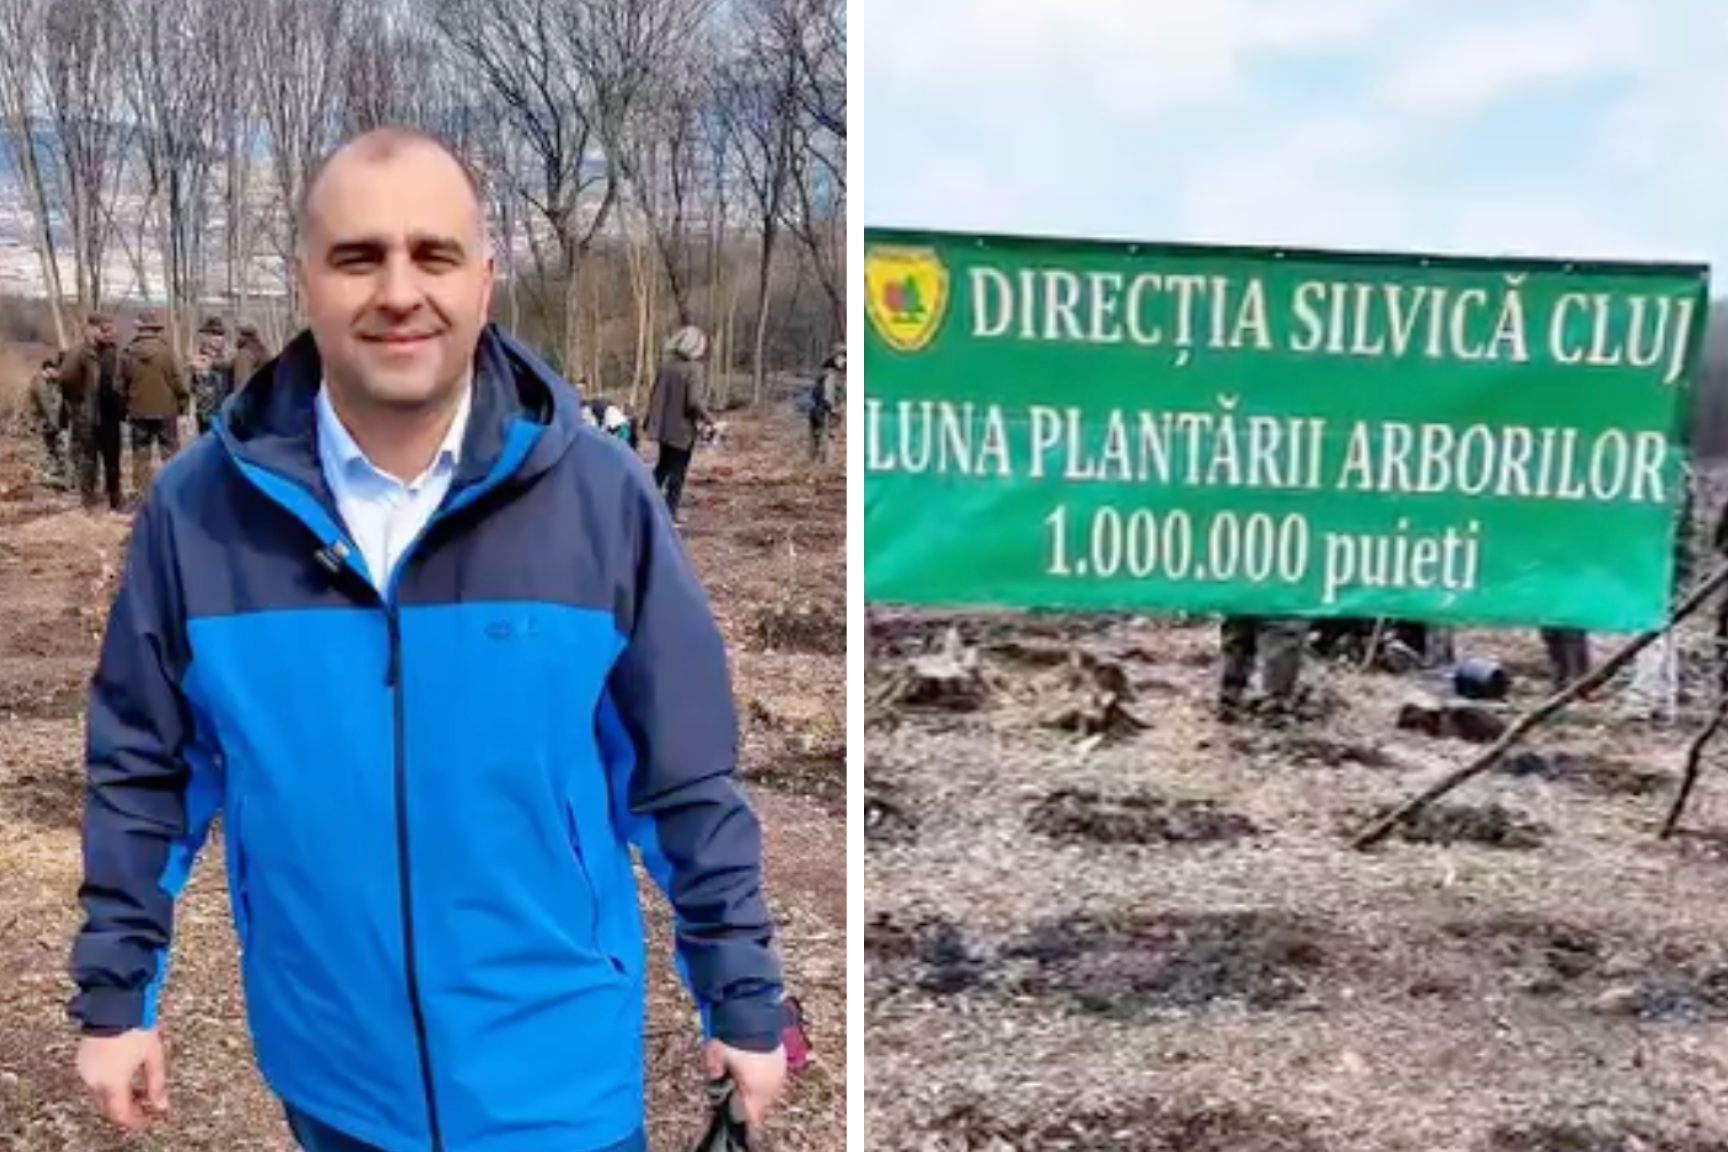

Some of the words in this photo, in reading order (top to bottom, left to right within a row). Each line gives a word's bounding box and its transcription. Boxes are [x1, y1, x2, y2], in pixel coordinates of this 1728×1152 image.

[969, 266, 1272, 366] DIRECȚIA
[1289, 272, 1530, 363] SILVICĂ
[1549, 293, 1696, 384] CLUJ
[866, 398, 1011, 478] LUNA
[1028, 394, 1326, 489] PLANTĂRII
[1337, 421, 1668, 503] ARBORILOR
[1044, 505, 1308, 583] 1.000.000
[1321, 517, 1481, 608] puieți
